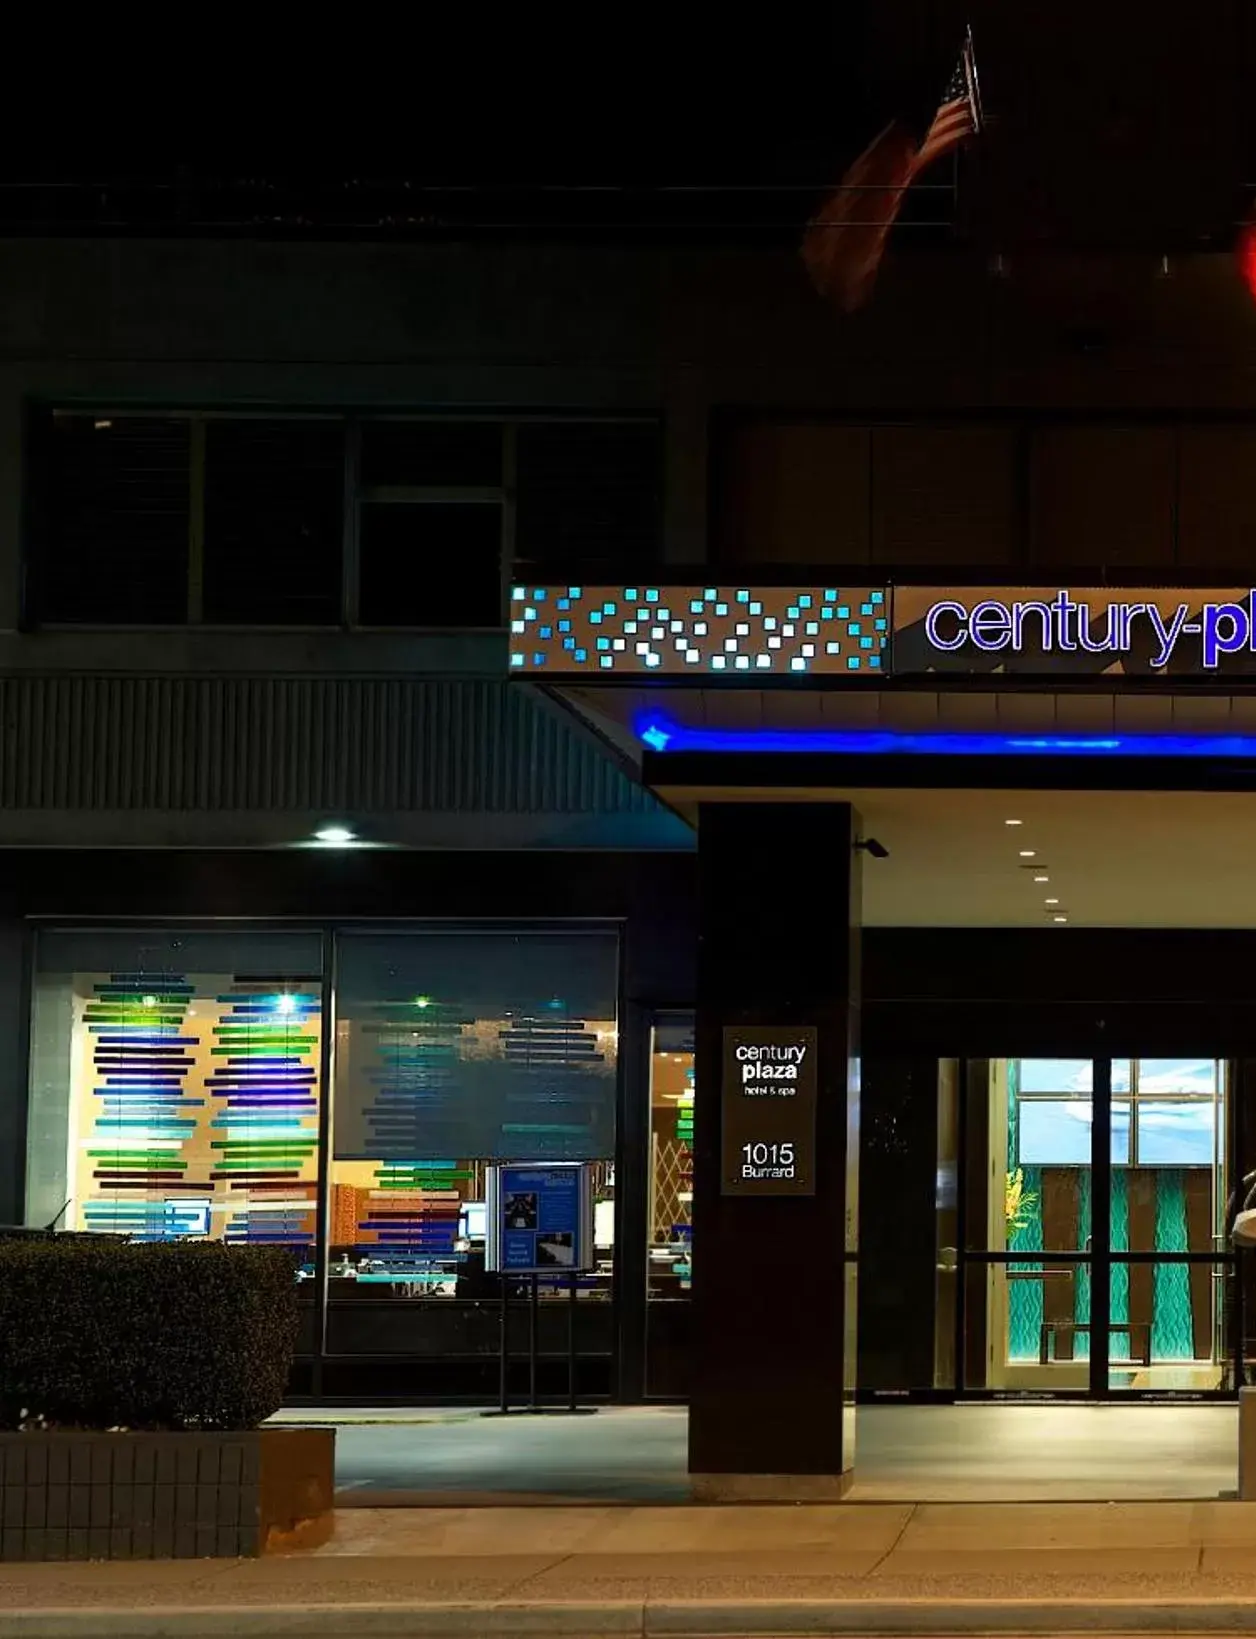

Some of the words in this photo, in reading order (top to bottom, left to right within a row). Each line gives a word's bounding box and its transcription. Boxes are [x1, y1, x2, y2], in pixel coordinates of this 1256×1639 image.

[735, 1045, 806, 1064] century
[742, 1061, 798, 1083] plaza
[742, 1143, 795, 1165] 1015
[742, 1164, 795, 1178] Burrard
